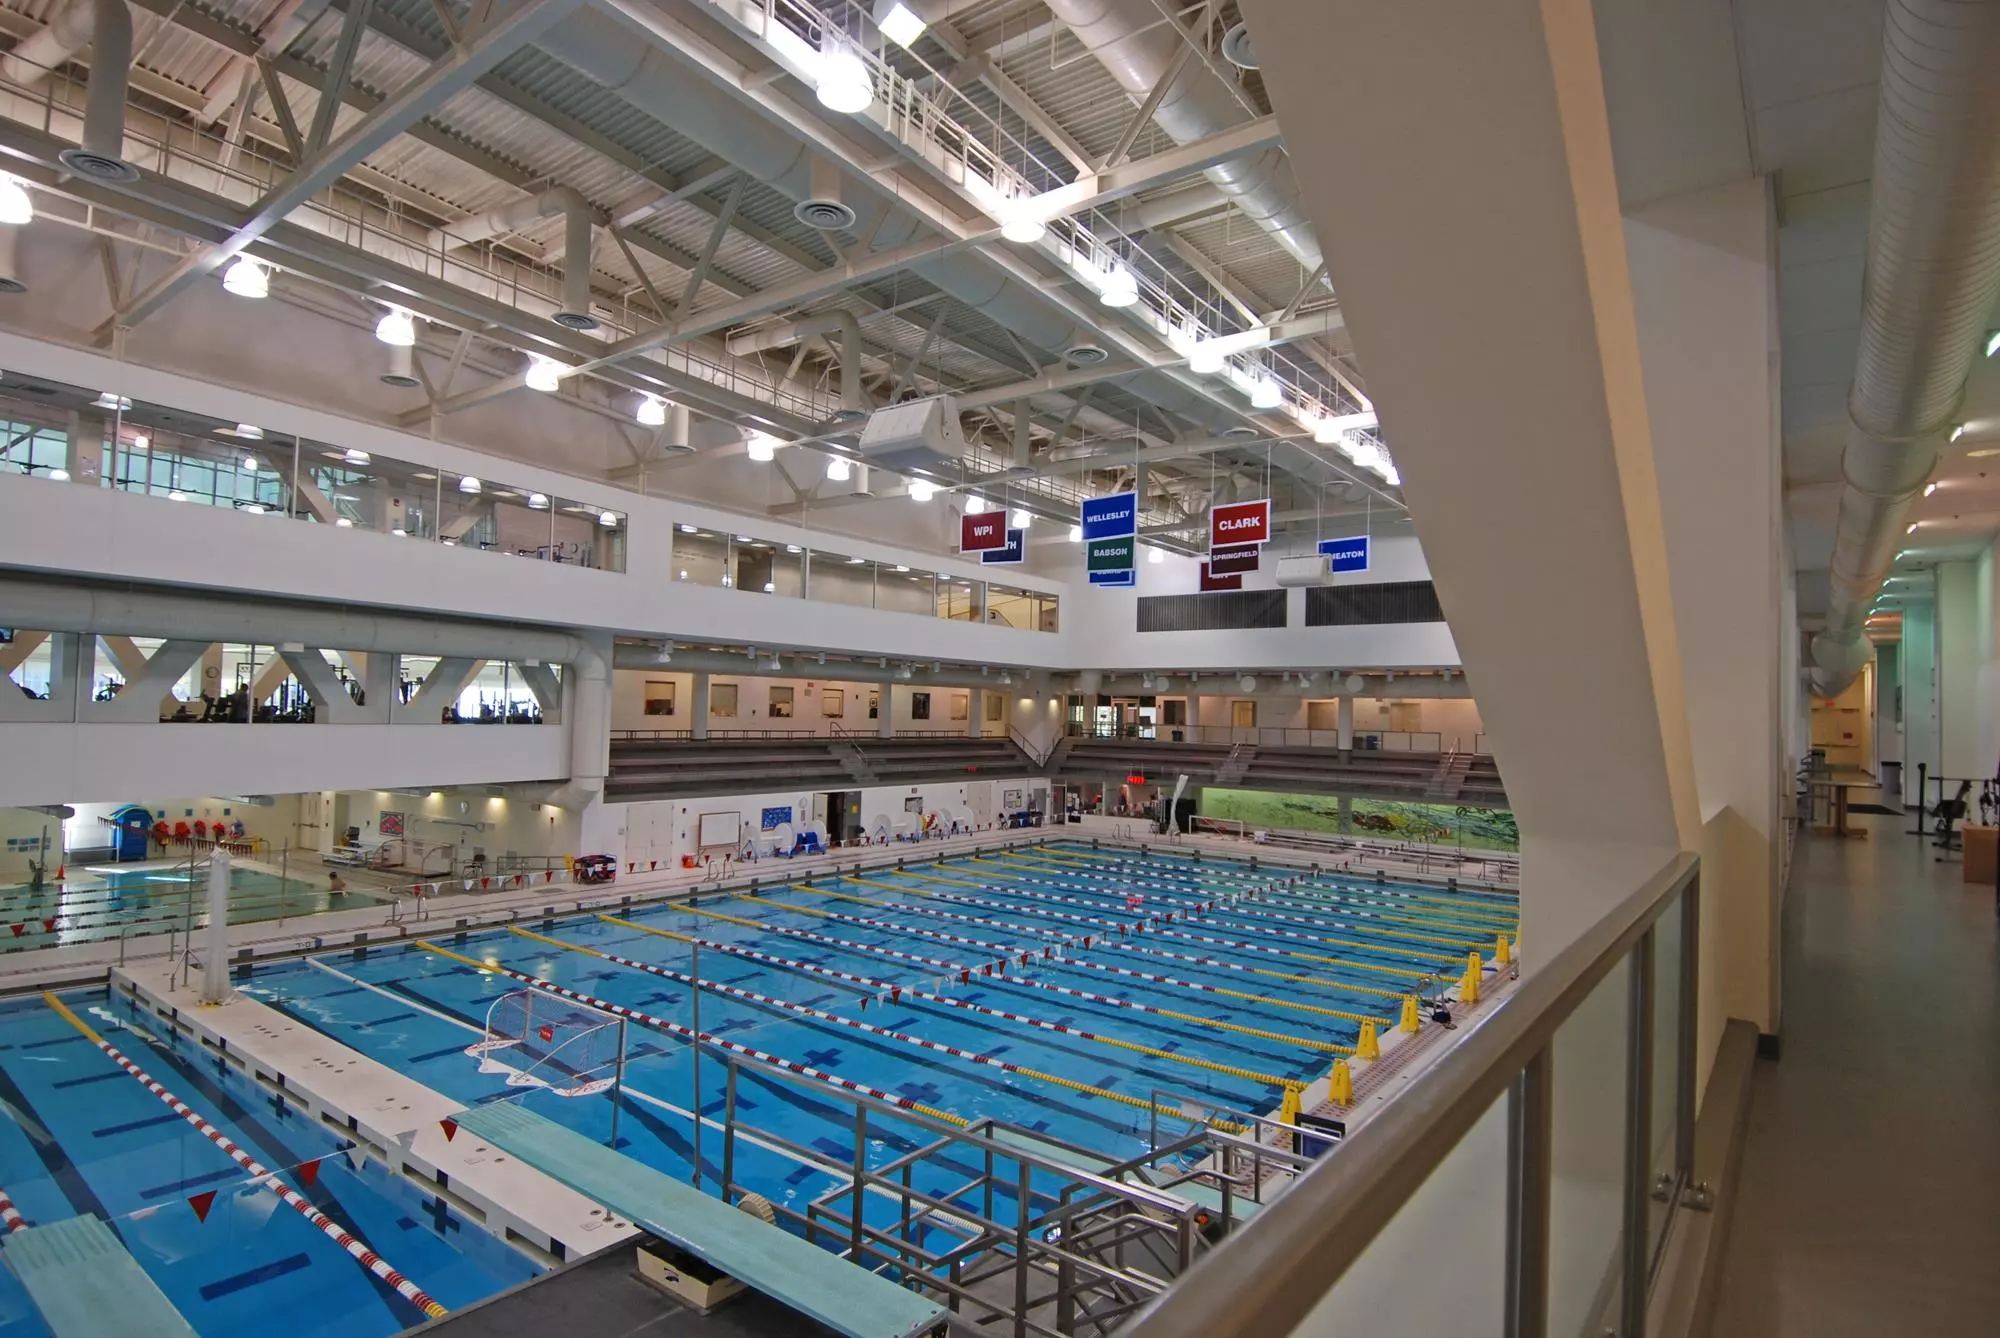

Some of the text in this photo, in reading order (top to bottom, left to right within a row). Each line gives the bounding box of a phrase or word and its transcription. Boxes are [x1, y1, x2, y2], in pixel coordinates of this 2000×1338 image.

[1087, 509, 1130, 523] WELLESLEY
[1219, 516, 1260, 531] CLARK
[973, 525, 993, 537] WPI
[1093, 547, 1128, 557] BABSON
[1212, 550, 1258, 561] SPRINGFIELD
[1332, 550, 1364, 560] EATON
